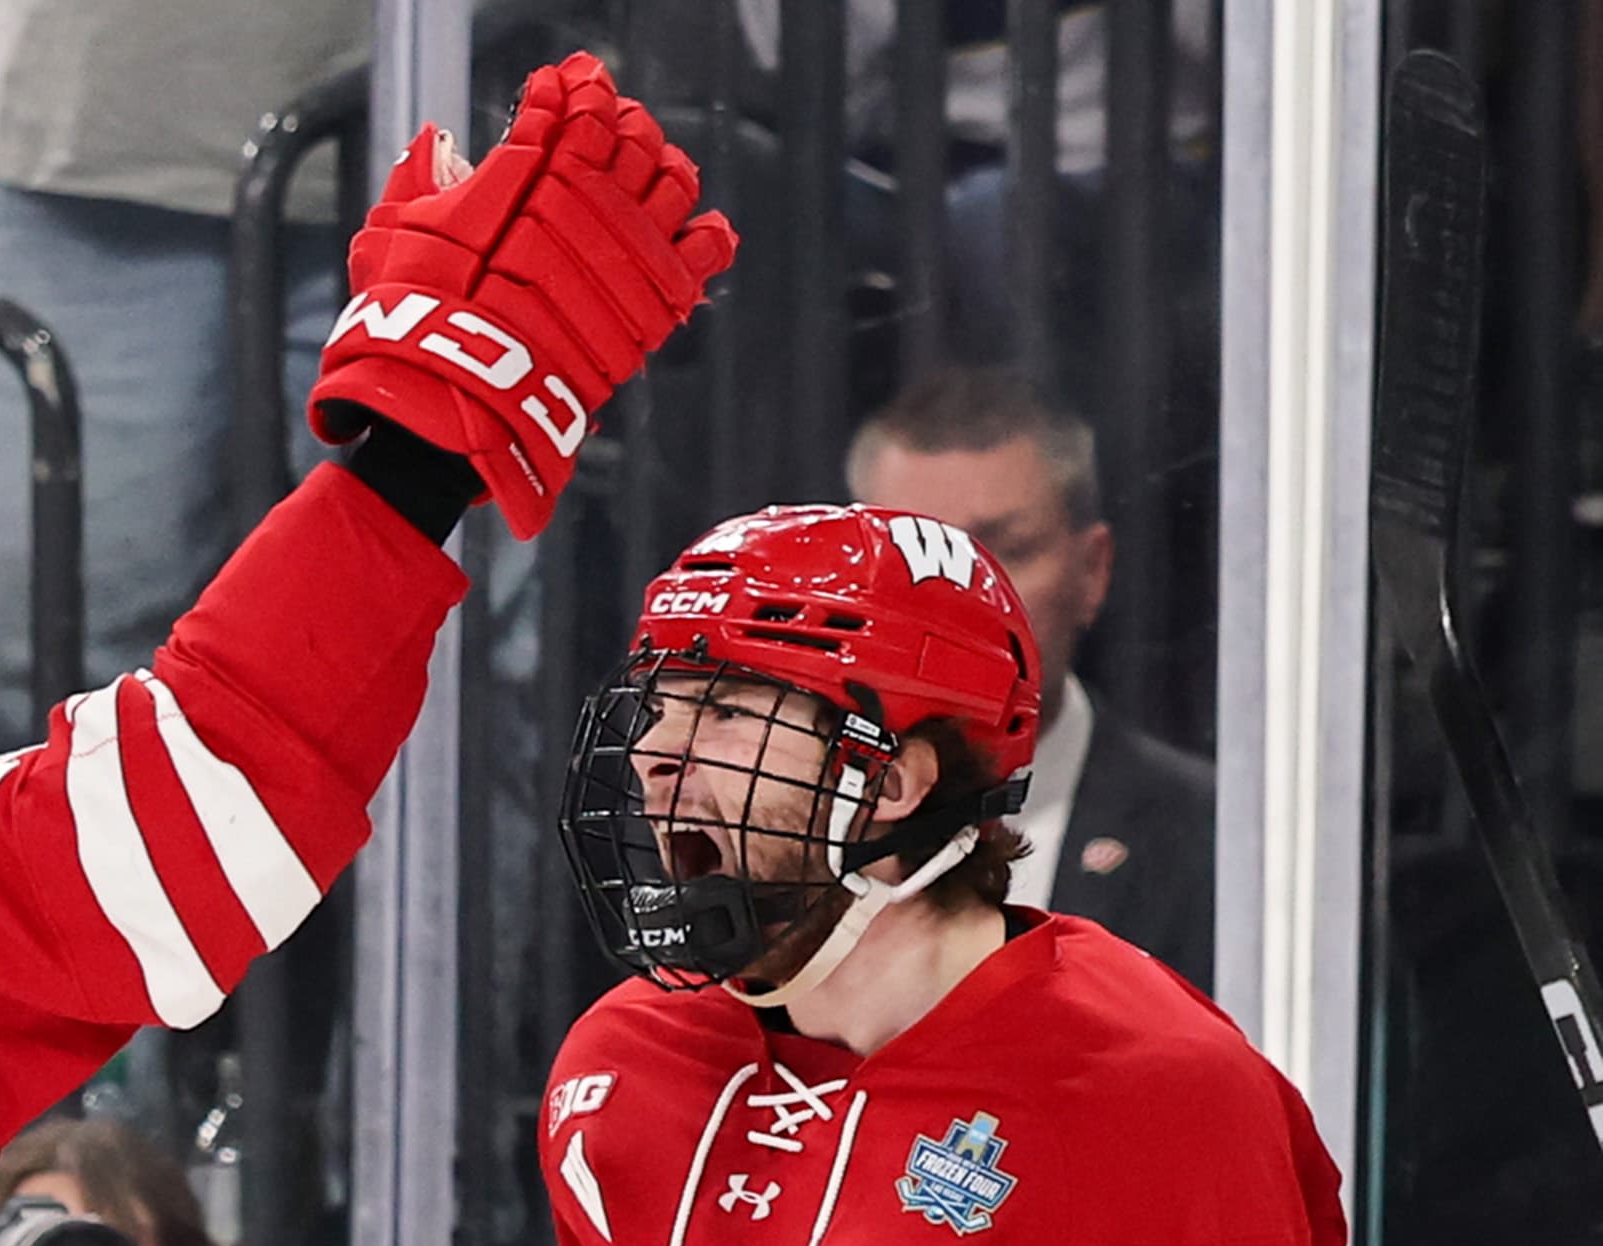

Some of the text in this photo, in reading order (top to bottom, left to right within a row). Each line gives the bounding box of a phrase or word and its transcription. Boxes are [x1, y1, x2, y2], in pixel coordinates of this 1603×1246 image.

[323, 291, 588, 458] CCM
[889, 515, 976, 591] W
[650, 591, 731, 614] CCM
[915, 1149, 970, 1186] FROZEN
[961, 1170, 1003, 1201] FOUR
